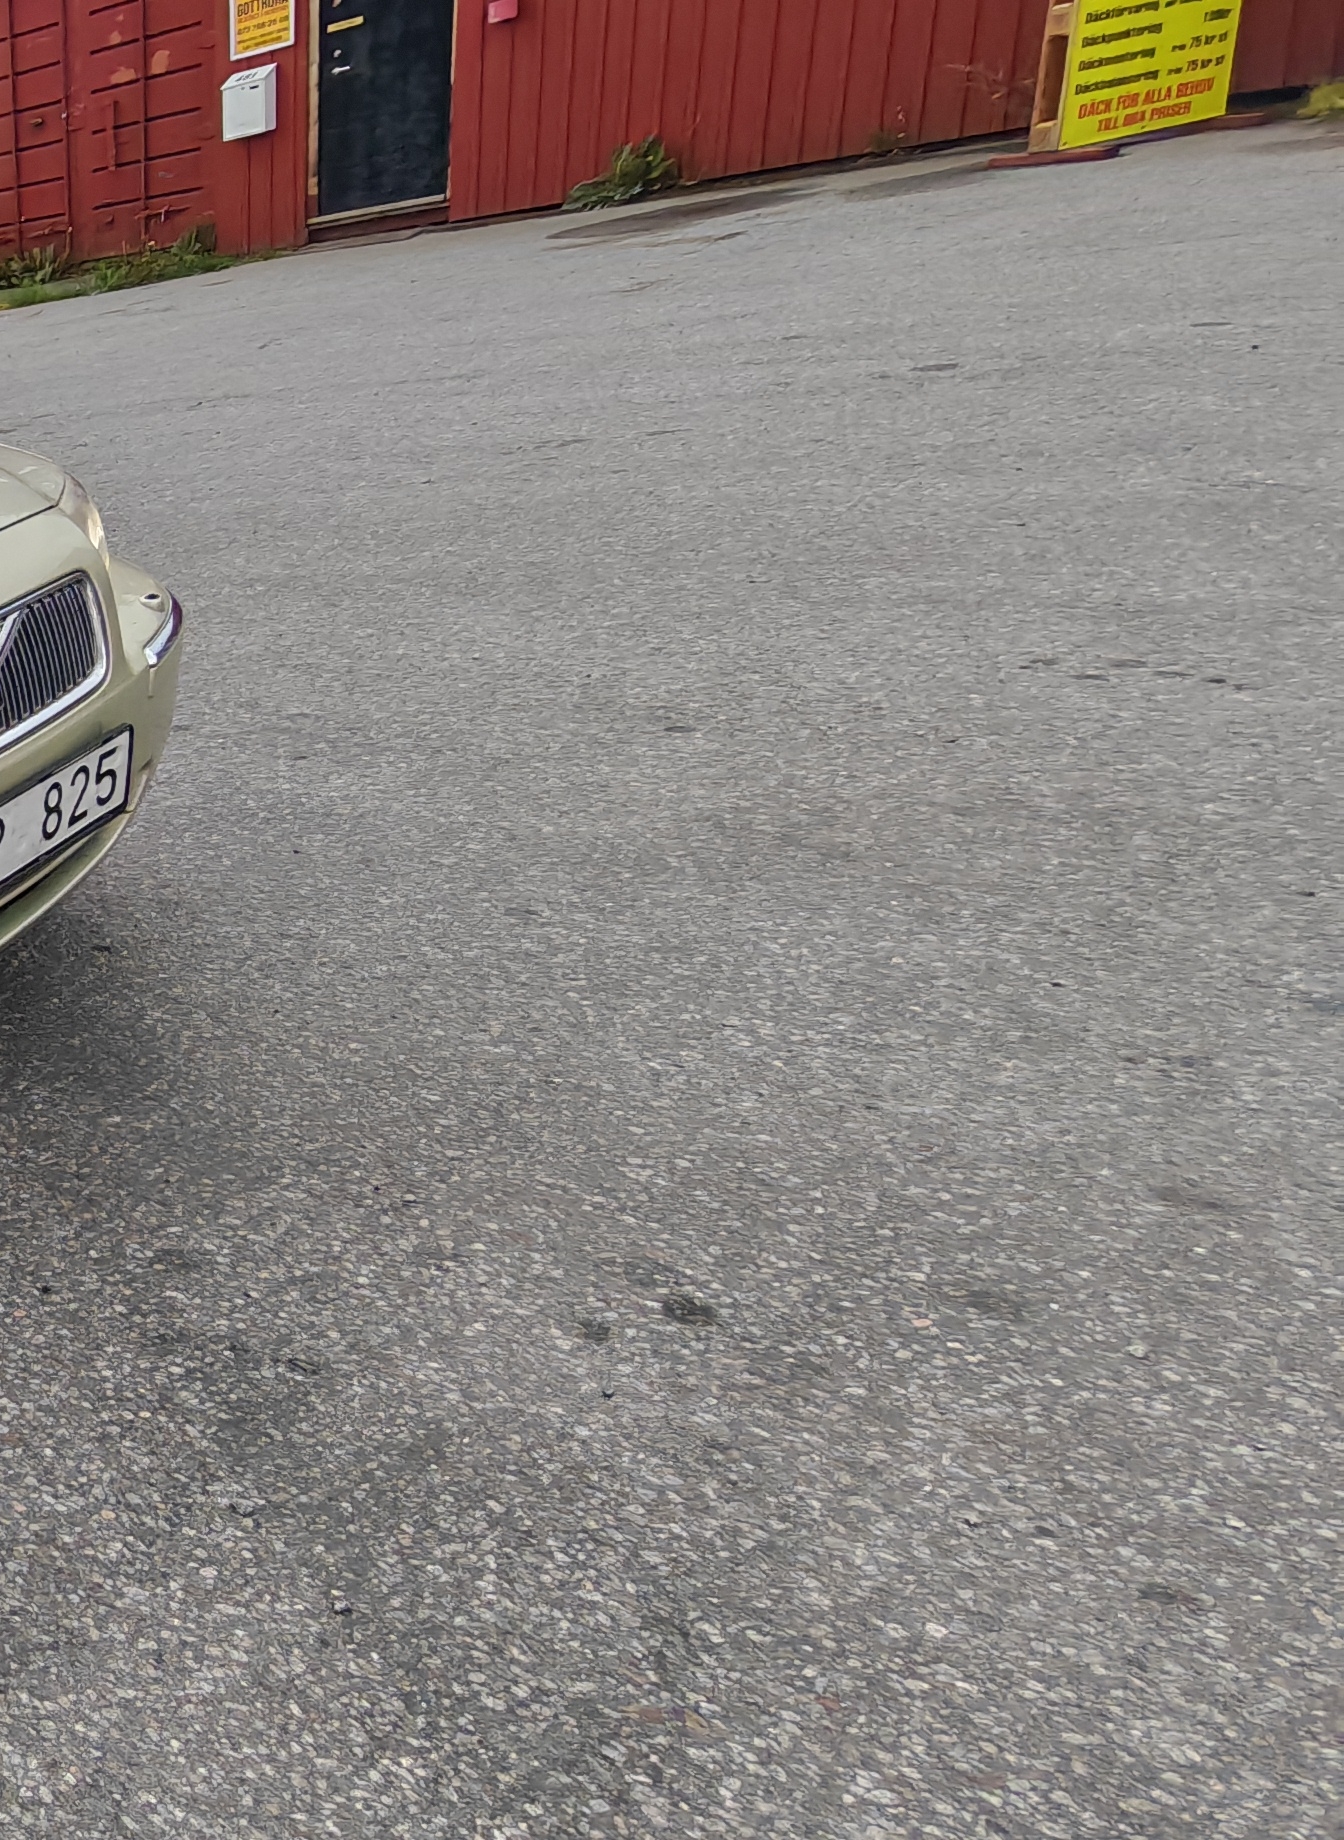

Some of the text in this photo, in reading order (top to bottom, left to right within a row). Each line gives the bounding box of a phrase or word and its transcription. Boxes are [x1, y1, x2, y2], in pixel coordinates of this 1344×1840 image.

[1078, 98, 1114, 119] DÄCK
[1142, 84, 1173, 106] ALLA
[42, 746, 119, 841] 825
